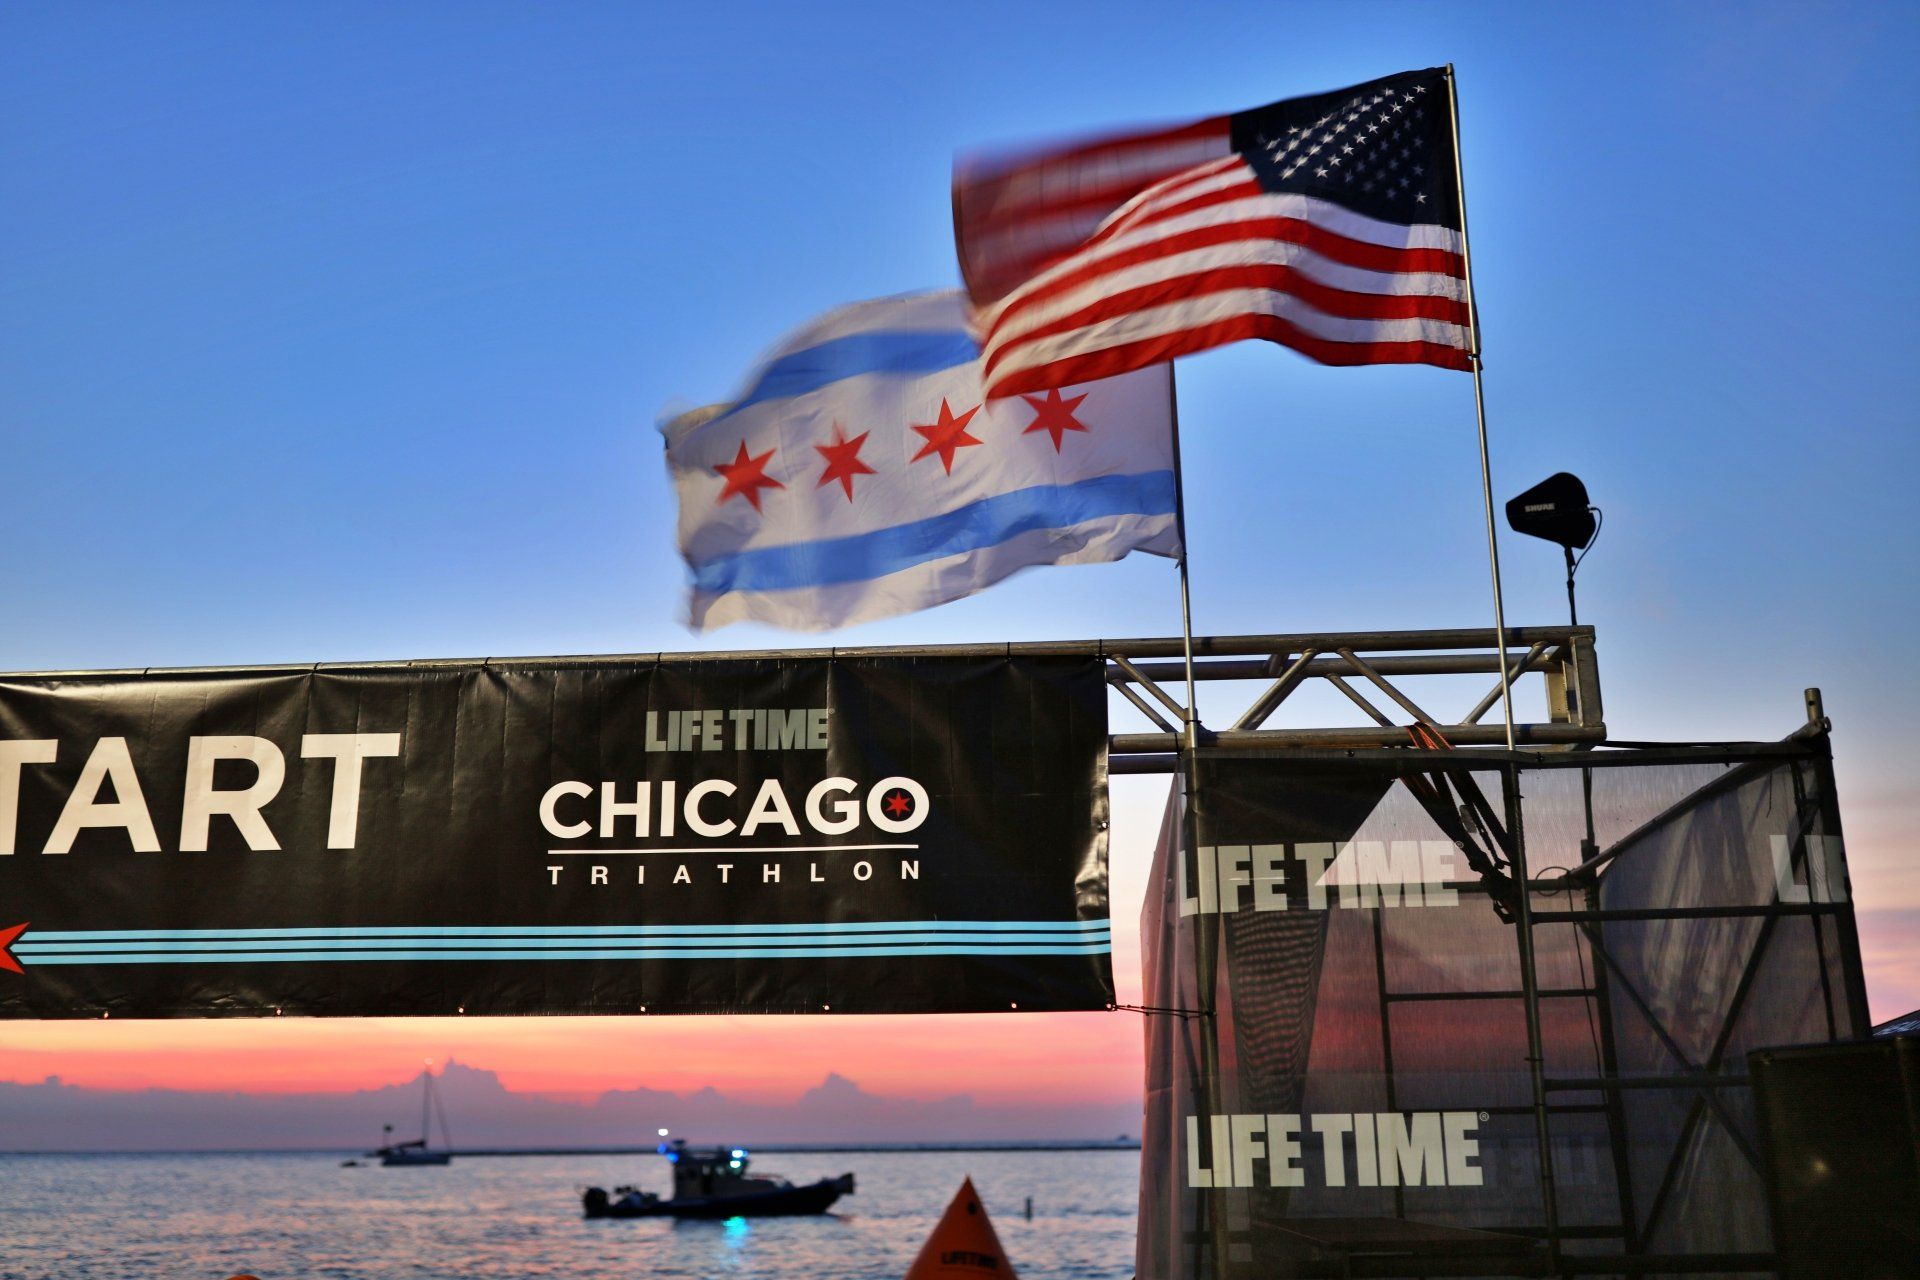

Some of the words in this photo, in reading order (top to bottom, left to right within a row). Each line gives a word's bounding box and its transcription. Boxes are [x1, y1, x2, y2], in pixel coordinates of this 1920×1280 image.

[1524, 502, 1555, 513] SHURE
[645, 709, 724, 752] LIFE
[729, 708, 829, 751] TIME
[539, 776, 930, 839] CHICAGO
[547, 860, 919, 885] TRIATHLON
[1179, 844, 1289, 918] LIFE
[1294, 840, 1460, 911] TIME
[1186, 1113, 1305, 1188] LIFE
[1311, 1111, 1484, 1187] TIME
